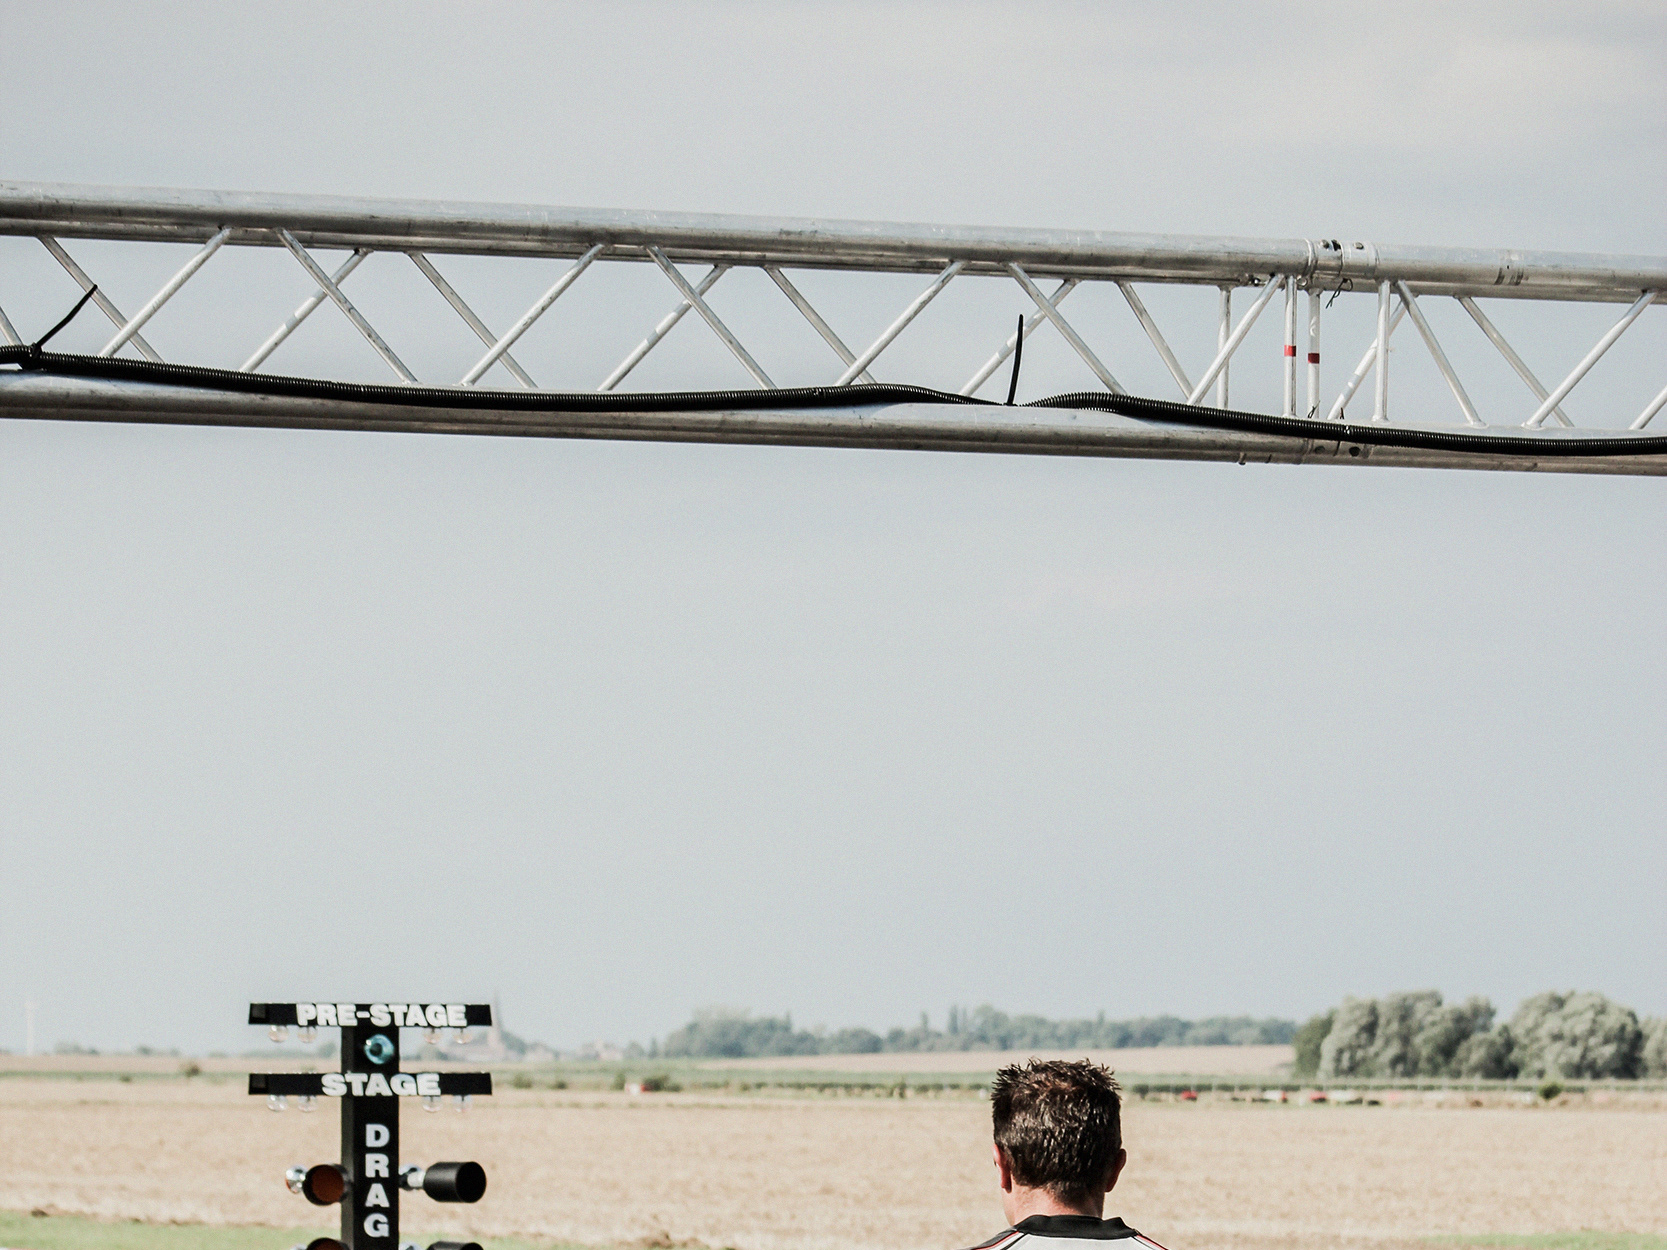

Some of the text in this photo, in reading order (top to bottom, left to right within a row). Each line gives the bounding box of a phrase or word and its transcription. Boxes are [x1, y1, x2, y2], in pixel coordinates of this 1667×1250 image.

[296, 1003, 467, 1027] PRE-STAGE
[321, 1072, 441, 1097] STAGE
[363, 1123, 390, 1238] DRAG
